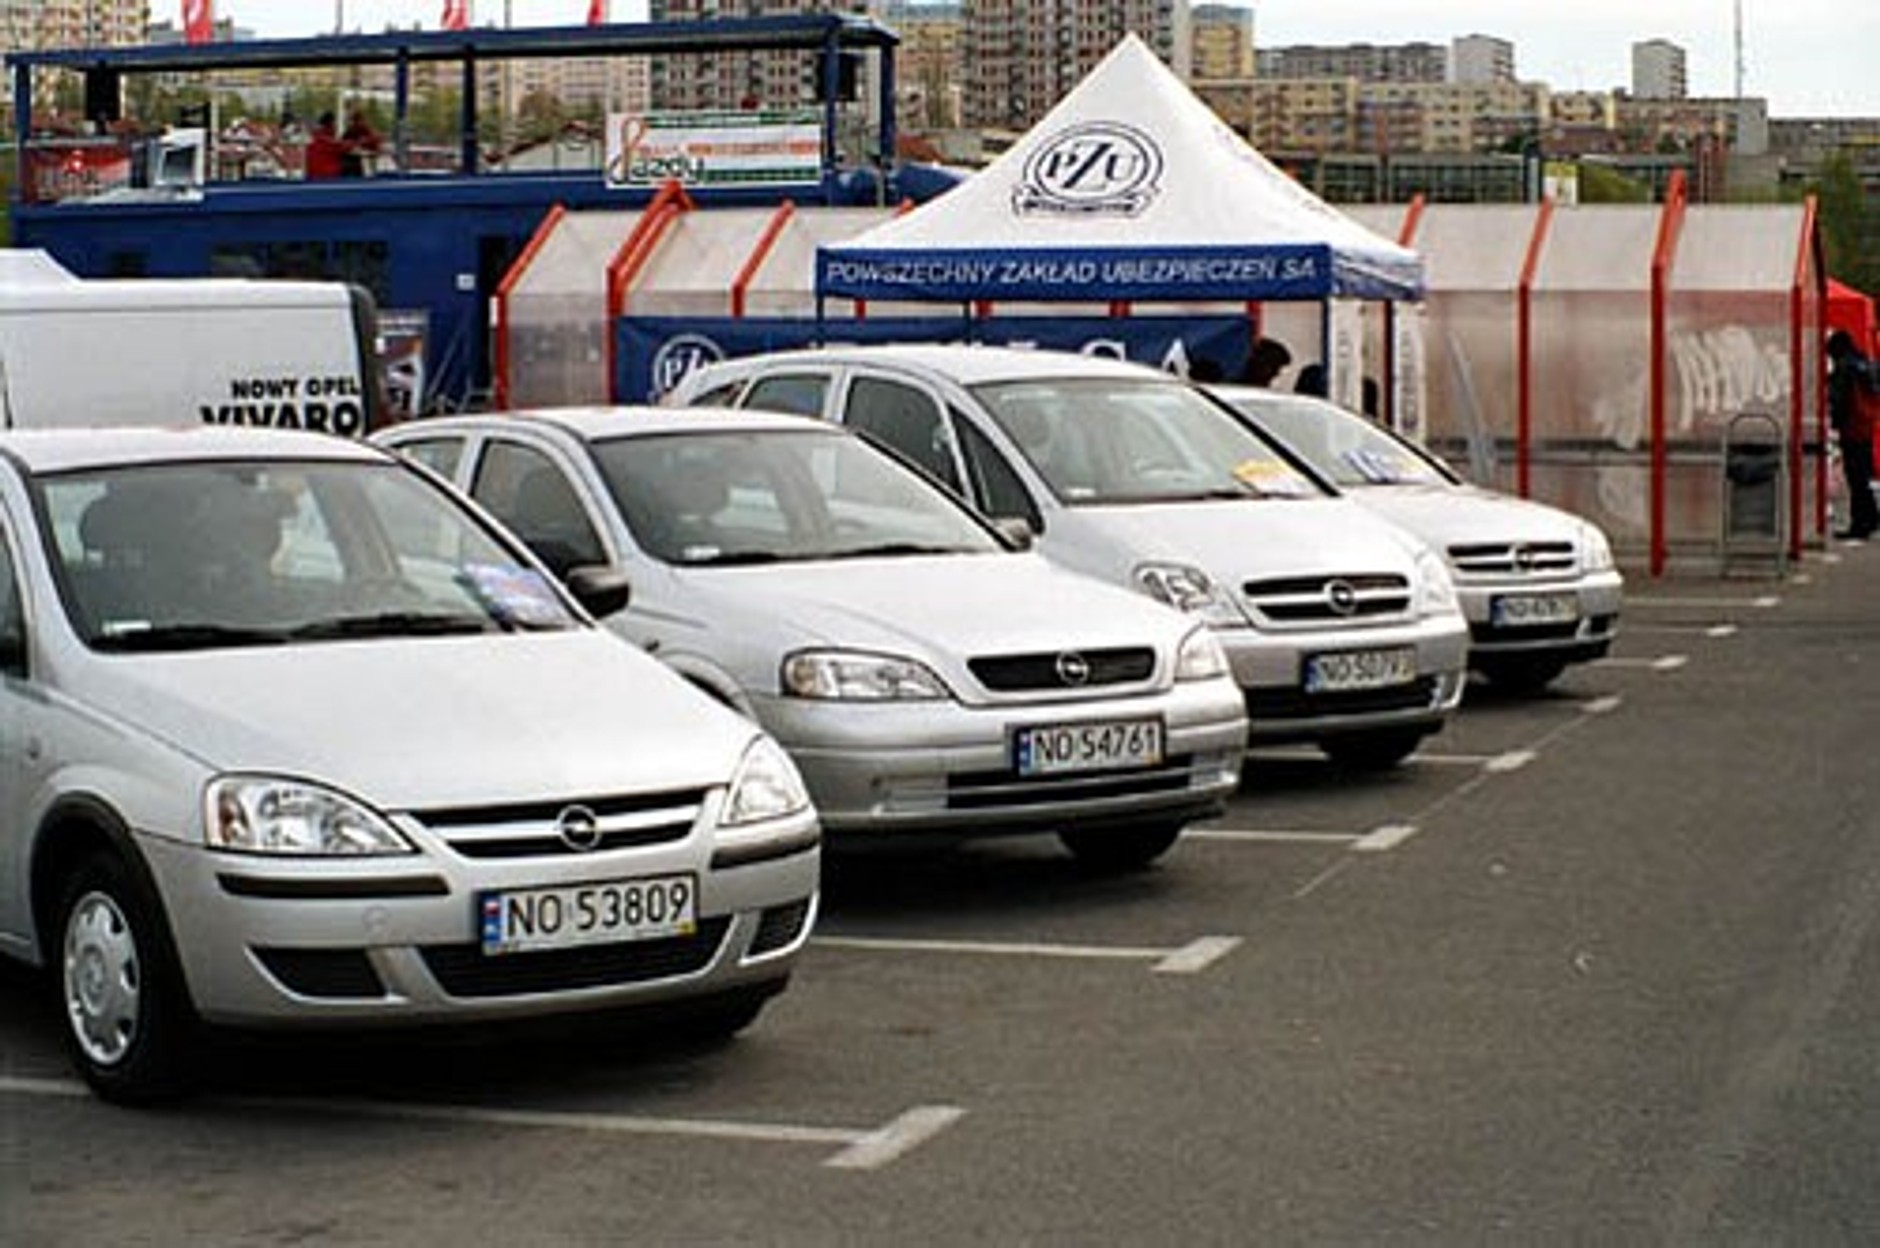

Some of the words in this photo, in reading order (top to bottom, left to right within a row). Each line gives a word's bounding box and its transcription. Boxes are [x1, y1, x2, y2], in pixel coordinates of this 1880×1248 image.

[1046, 143, 1138, 189] PZU
[827, 261, 994, 284] POWSZECHNY
[1000, 260, 1096, 284] ZAKŁAD
[1282, 257, 1317, 280] SA
[232, 379, 297, 399] NOWY
[305, 376, 360, 397] OPEL
[201, 402, 359, 438] VIVARO
[1034, 729, 1073, 761] NO
[1081, 723, 1156, 760] 54761
[507, 893, 562, 937] NO
[576, 882, 690, 931] 53809
